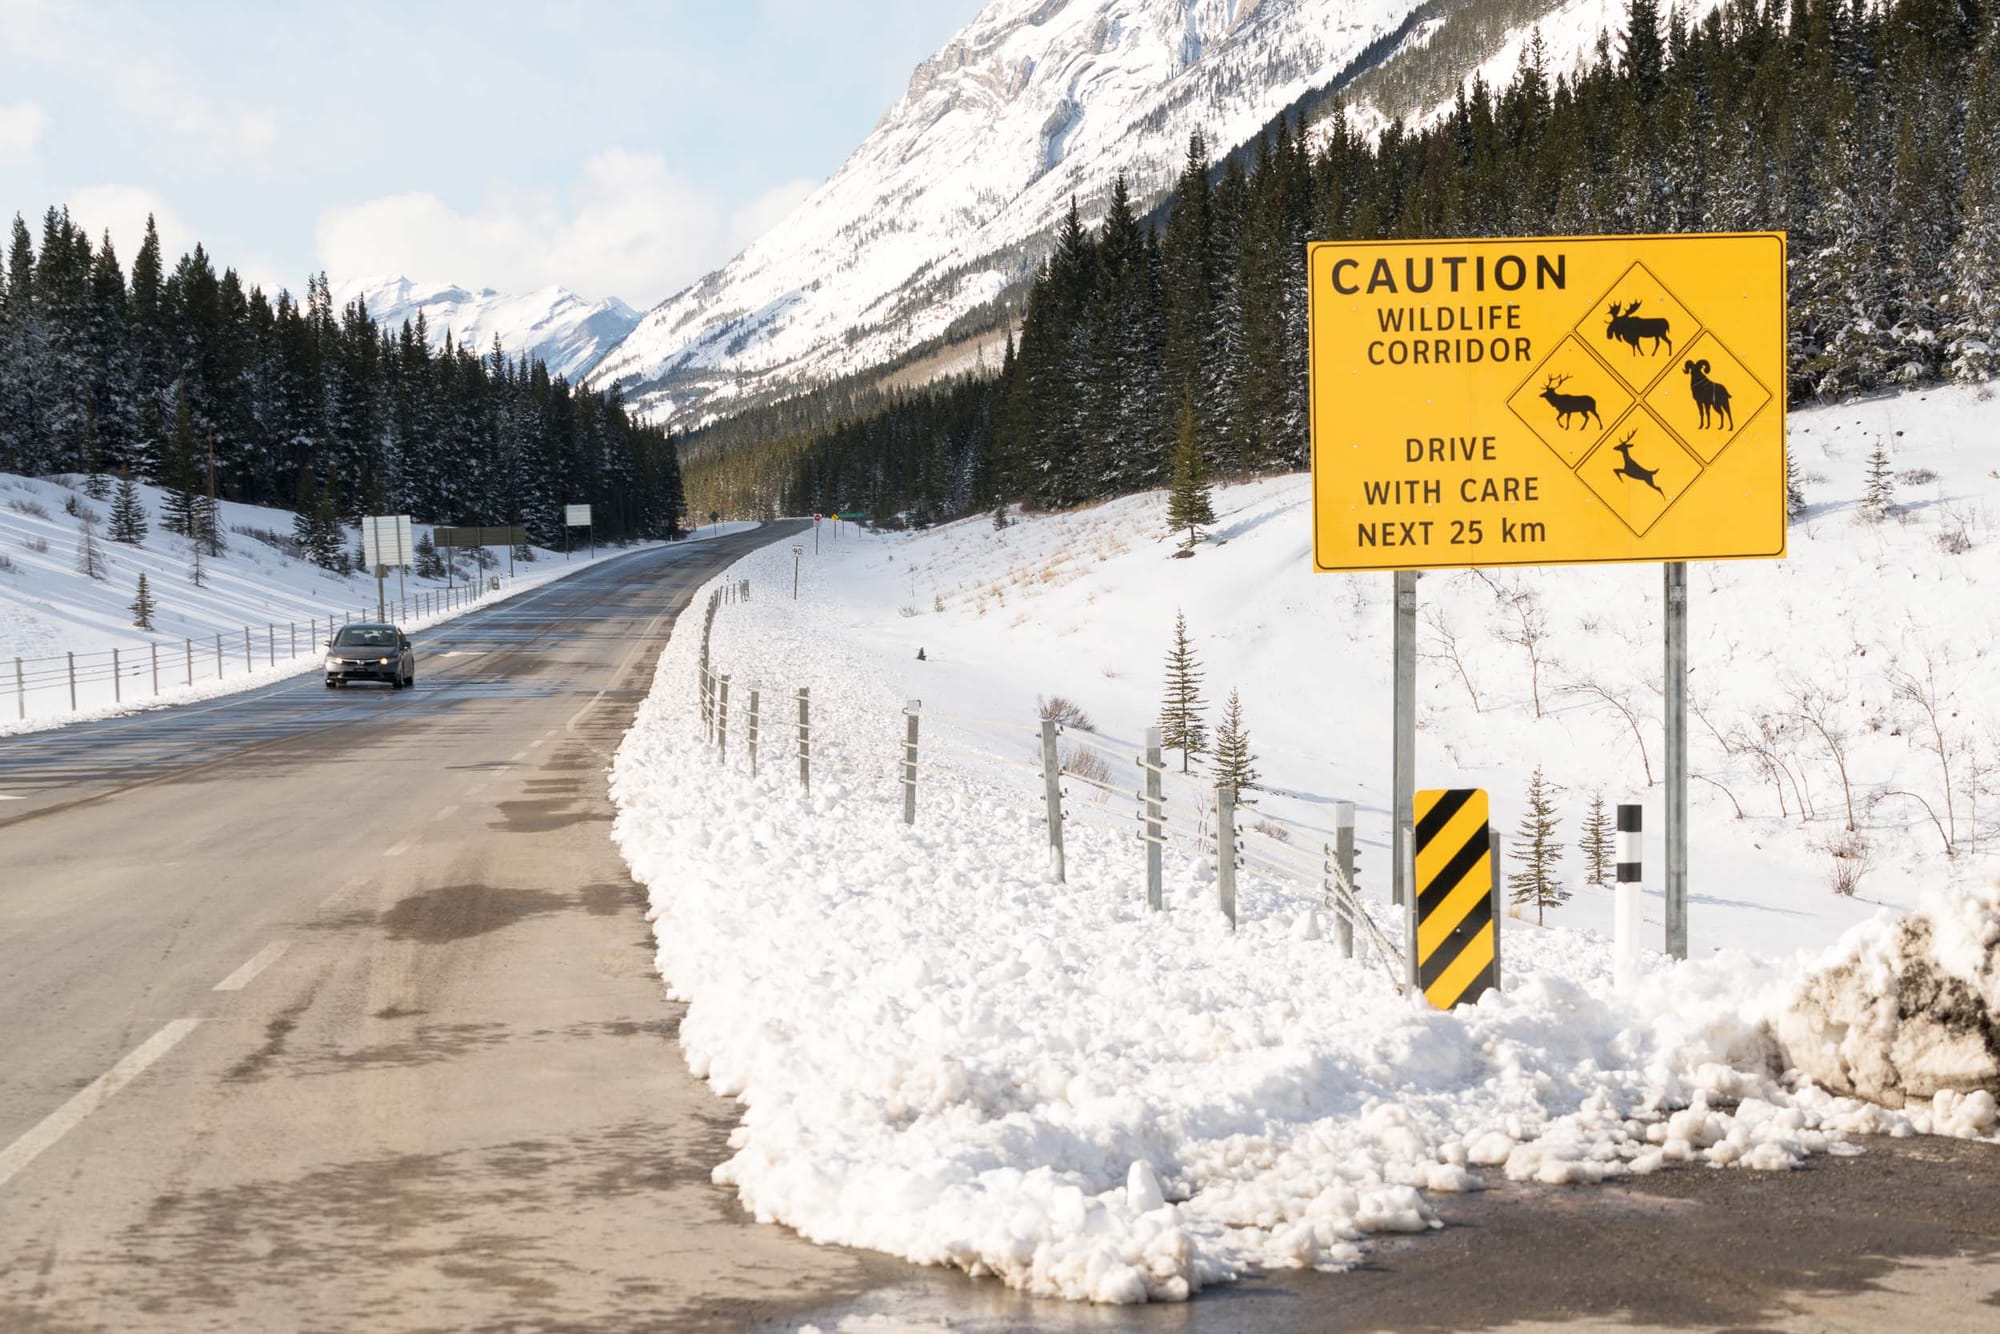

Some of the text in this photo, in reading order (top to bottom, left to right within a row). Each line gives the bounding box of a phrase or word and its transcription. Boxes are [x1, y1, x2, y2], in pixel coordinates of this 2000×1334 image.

[1331, 254, 1566, 295] CAUTION
[1377, 304, 1521, 333] WILDLIFE
[1368, 337, 1531, 365] CORRIDOR
[1406, 436, 1496, 463] DRIVE
[1364, 477, 1539, 505] WITH CARE
[1358, 517, 1546, 547] NEXT 25 km
